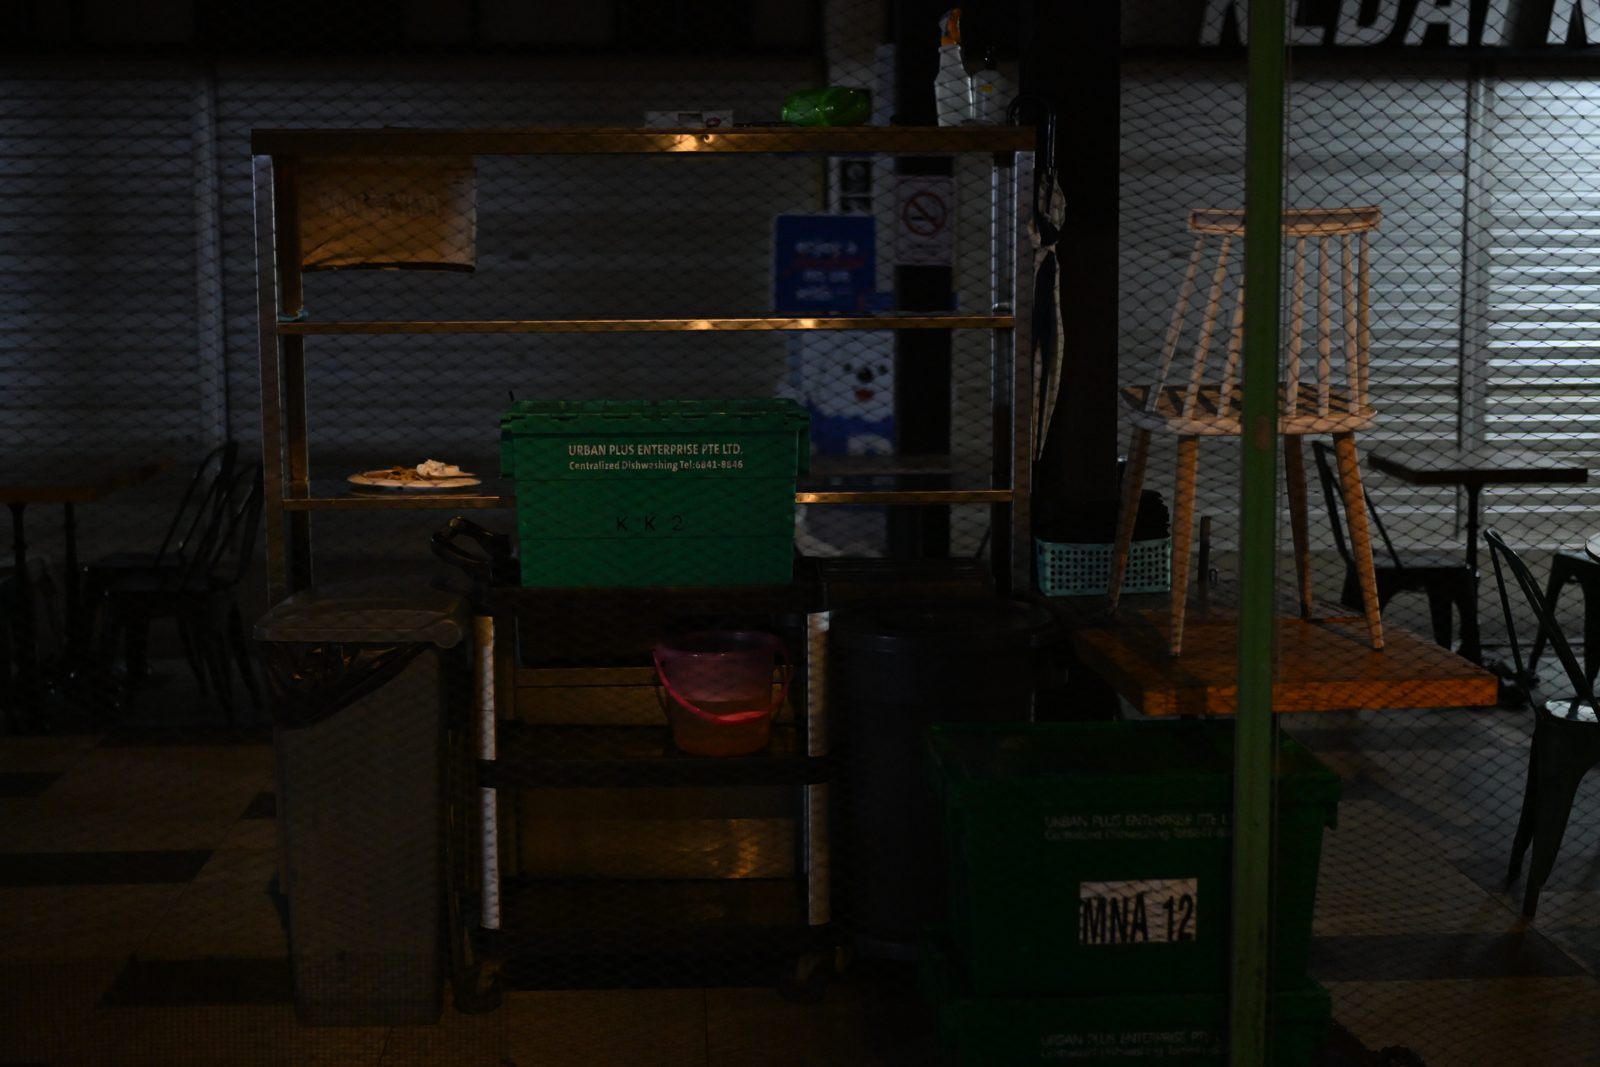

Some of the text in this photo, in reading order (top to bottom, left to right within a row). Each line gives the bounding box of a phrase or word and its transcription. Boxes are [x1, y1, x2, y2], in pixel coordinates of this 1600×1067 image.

[568, 443, 744, 456] URBAN PLUS ENTERPRISE PTE LTD.
[569, 460, 620, 470] Centralized
[621, 460, 678, 472] Dishwashing
[1083, 892, 1194, 943] MNA 12
